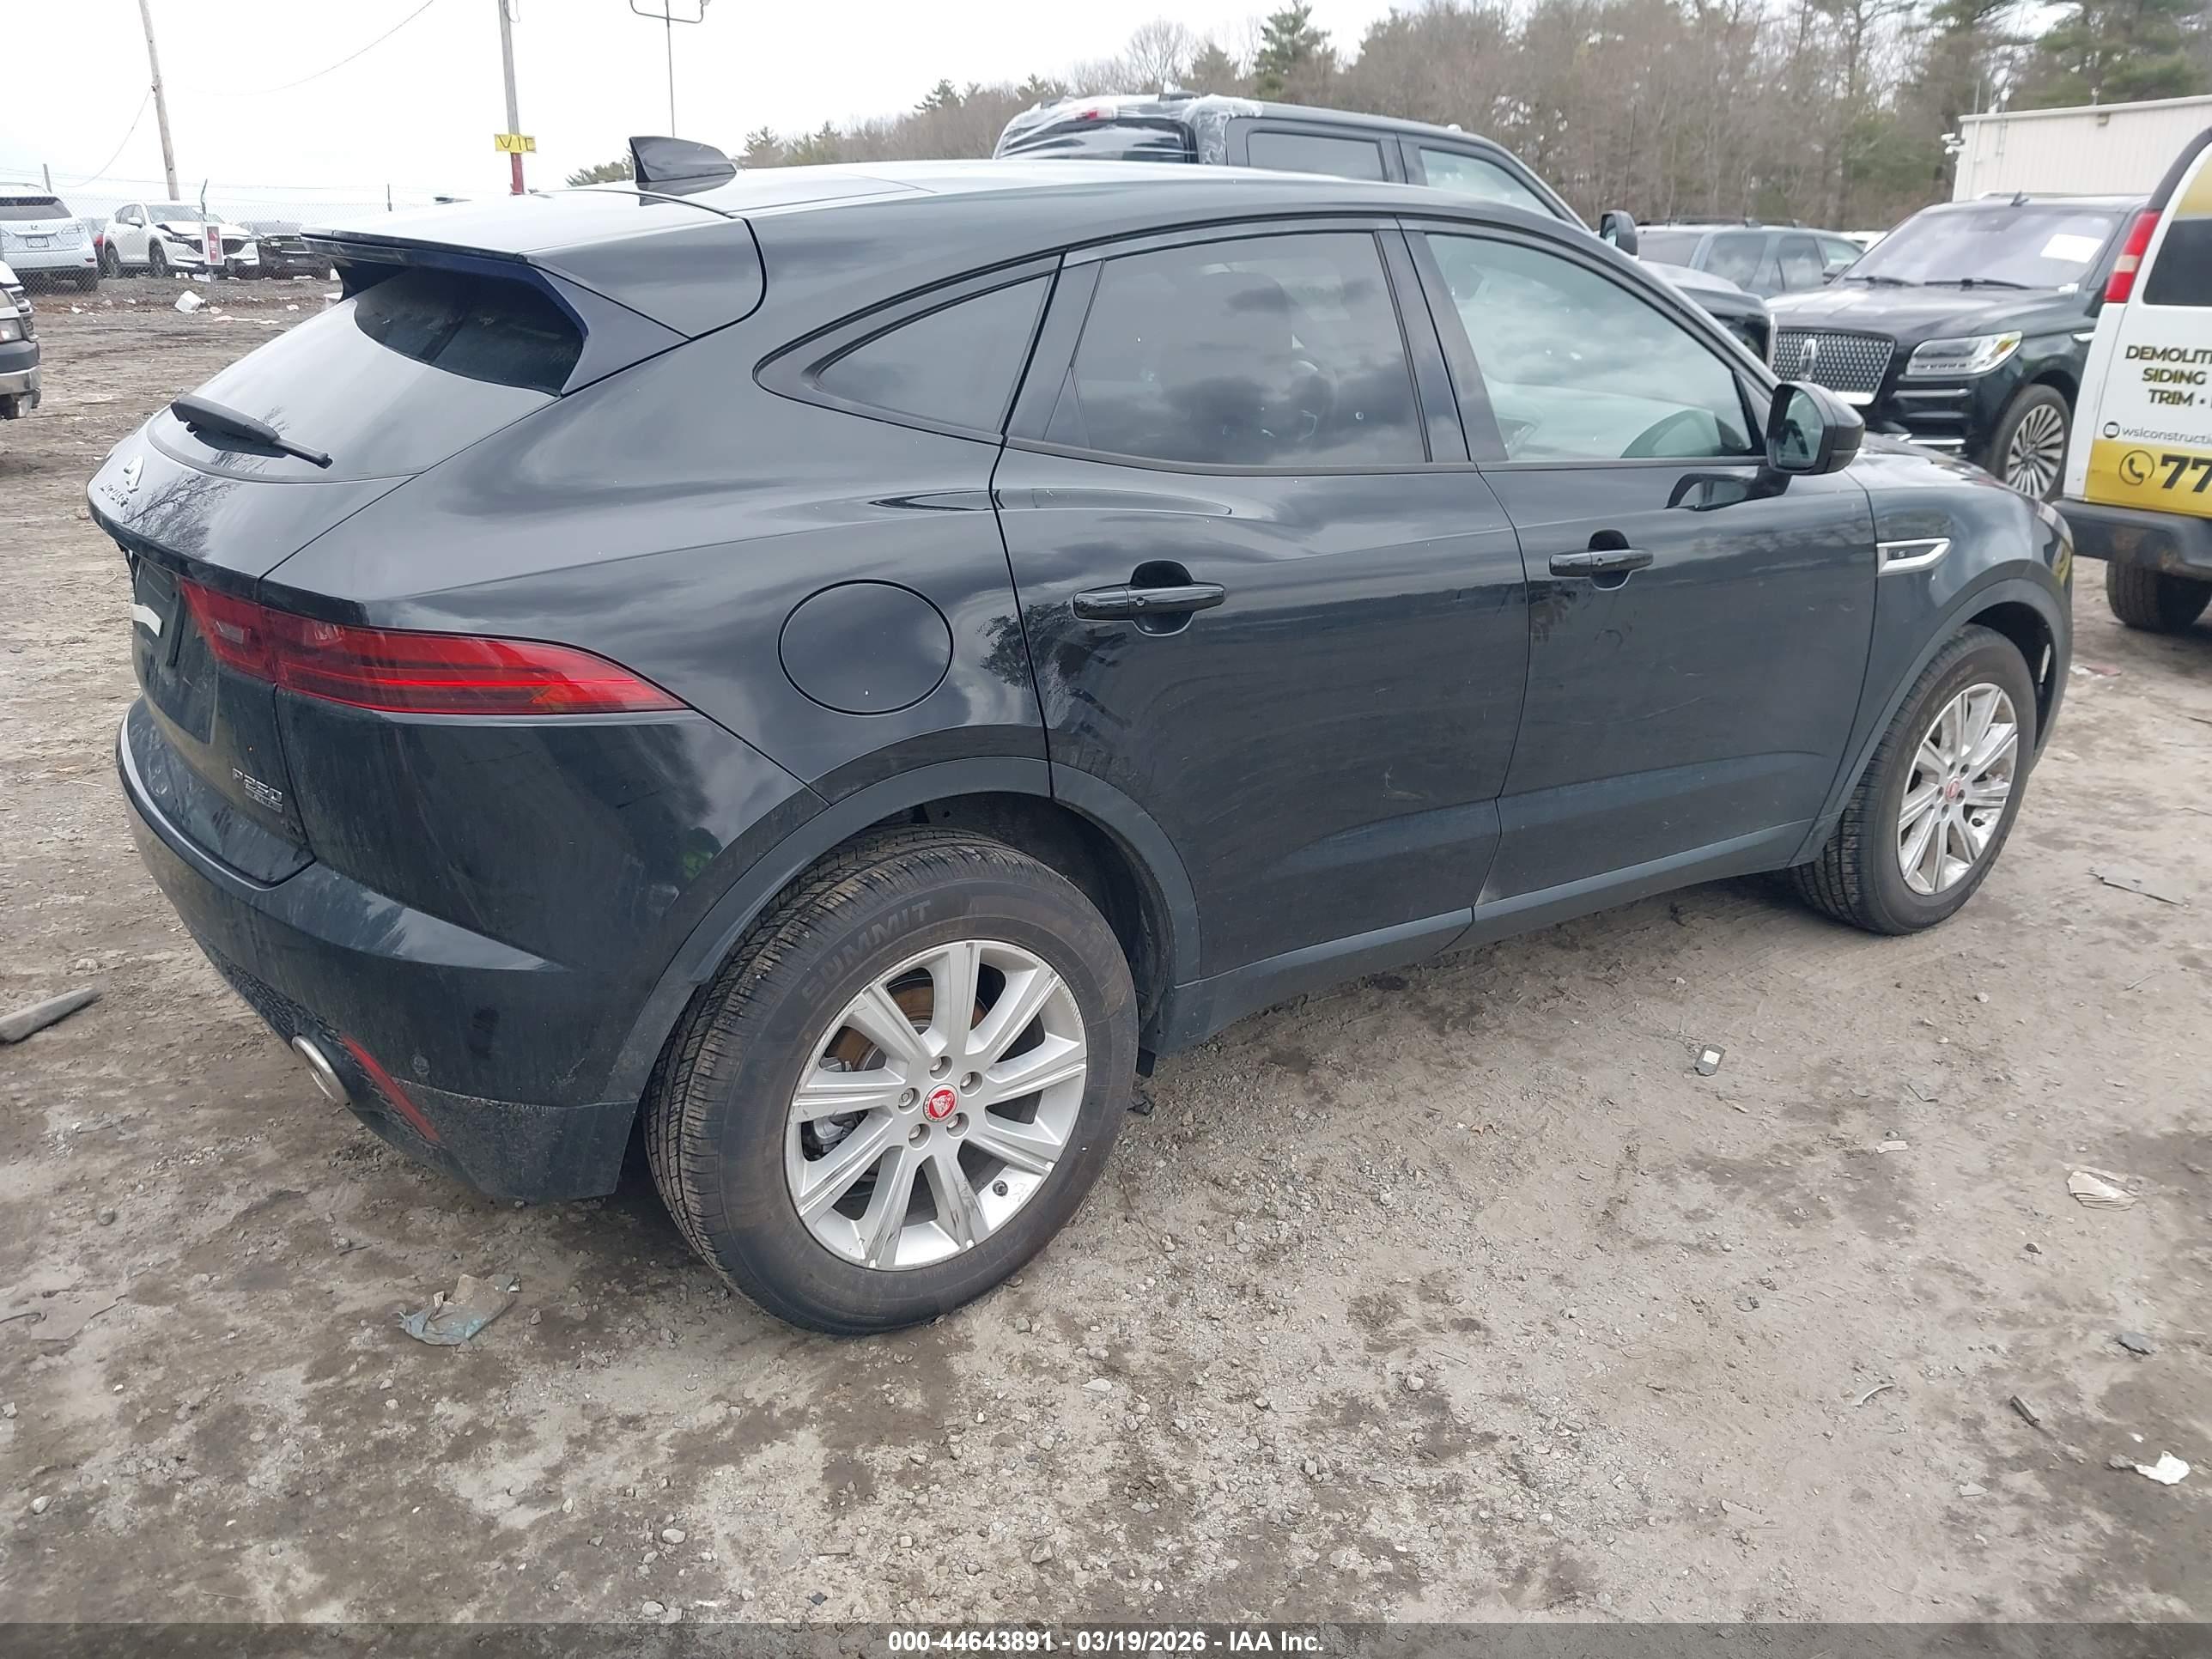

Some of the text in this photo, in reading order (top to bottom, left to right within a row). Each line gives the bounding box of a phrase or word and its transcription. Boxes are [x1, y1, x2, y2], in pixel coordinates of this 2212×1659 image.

[2142, 367, 2207, 386] SIDING
[2148, 388, 2195, 407] TRIM
[800, 899, 932, 1000] SUMMIT
